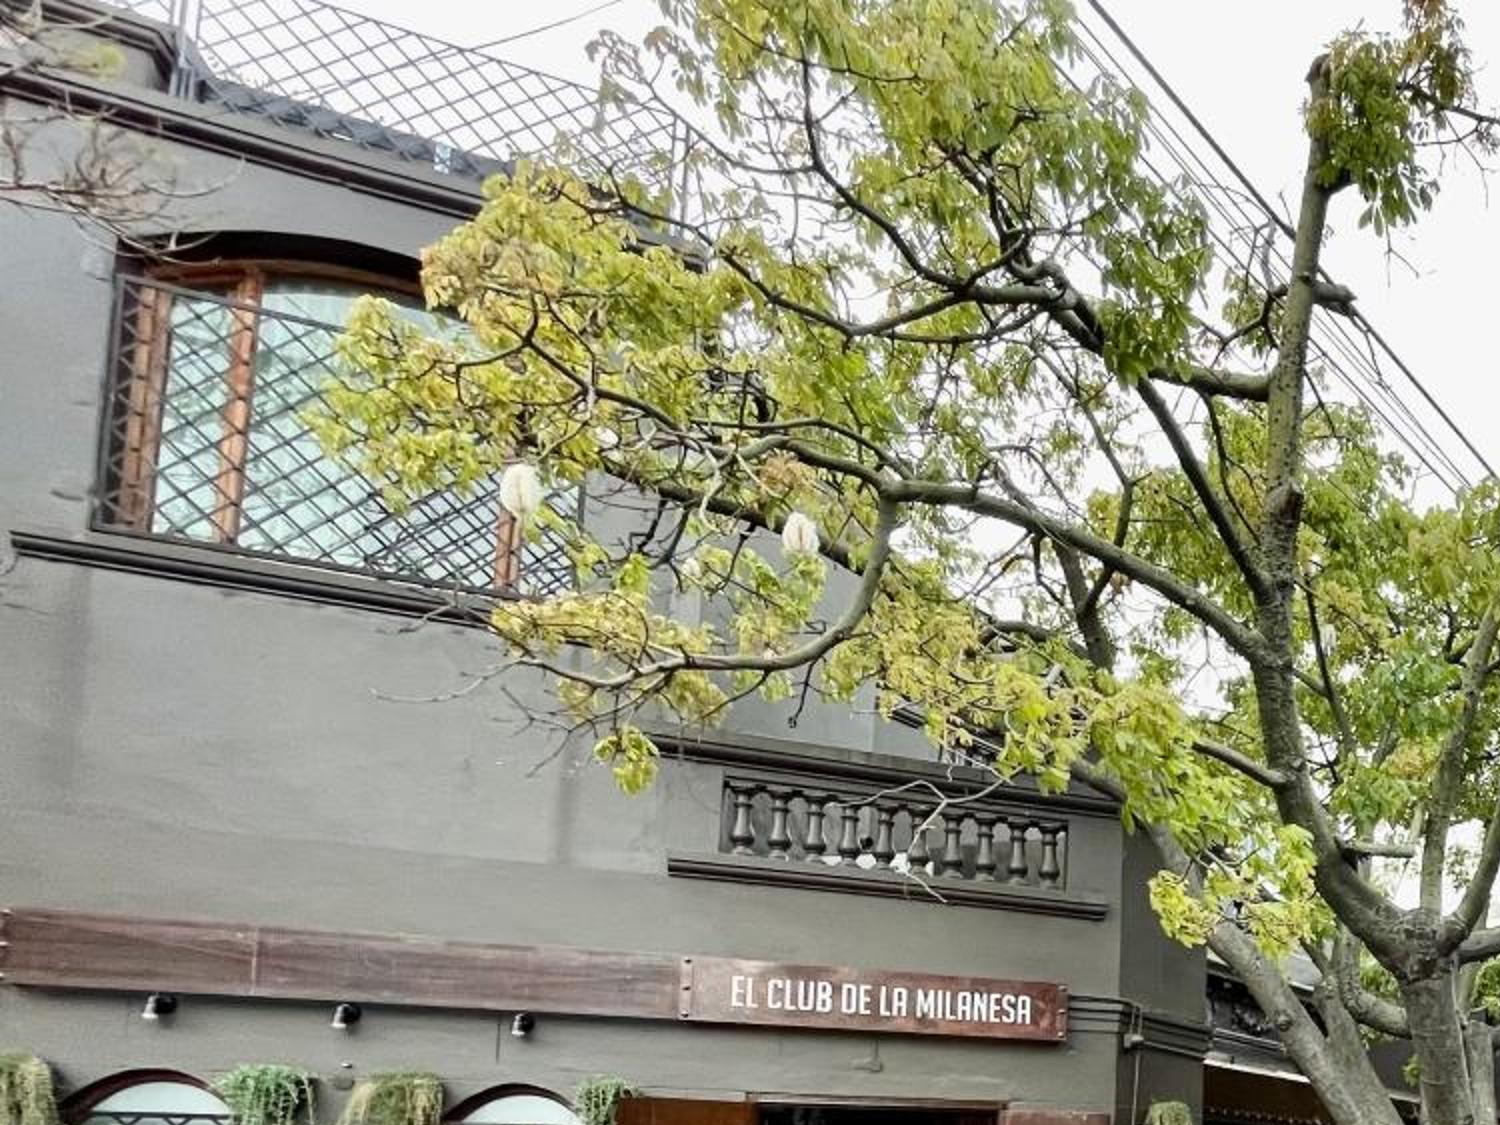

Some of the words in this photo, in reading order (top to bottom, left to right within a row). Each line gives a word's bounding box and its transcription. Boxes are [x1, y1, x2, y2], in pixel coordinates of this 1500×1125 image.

[731, 975, 758, 1008] EL
[767, 979, 833, 1013] CLUB
[841, 983, 871, 1015] DE
[879, 986, 907, 1017] LA
[916, 989, 1031, 1025] MILANESA
